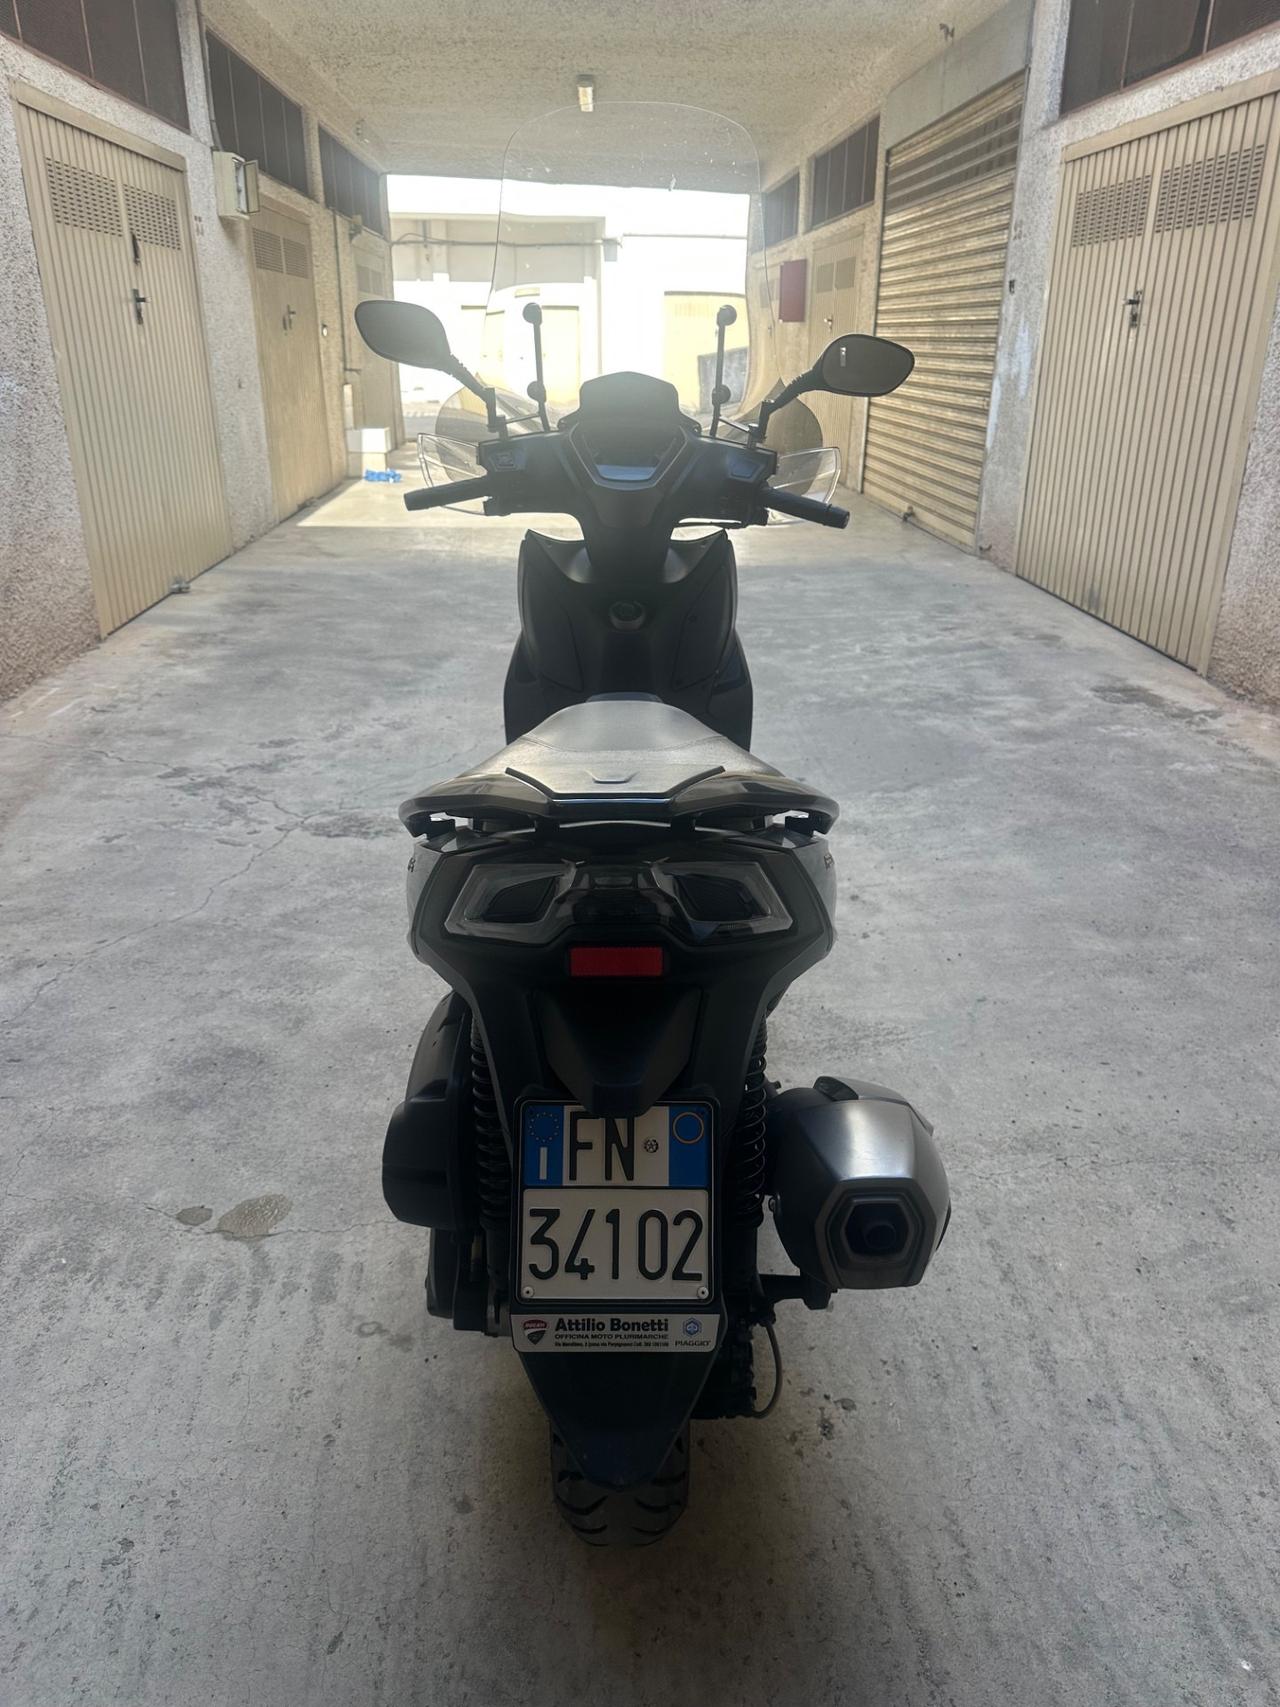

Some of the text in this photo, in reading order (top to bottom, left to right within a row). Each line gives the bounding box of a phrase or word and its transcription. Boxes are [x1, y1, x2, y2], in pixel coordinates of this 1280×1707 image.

[569, 1111, 634, 1181] FN
[529, 1208, 703, 1281] 34102
[555, 1318, 668, 1331] Attilio Bonetti
